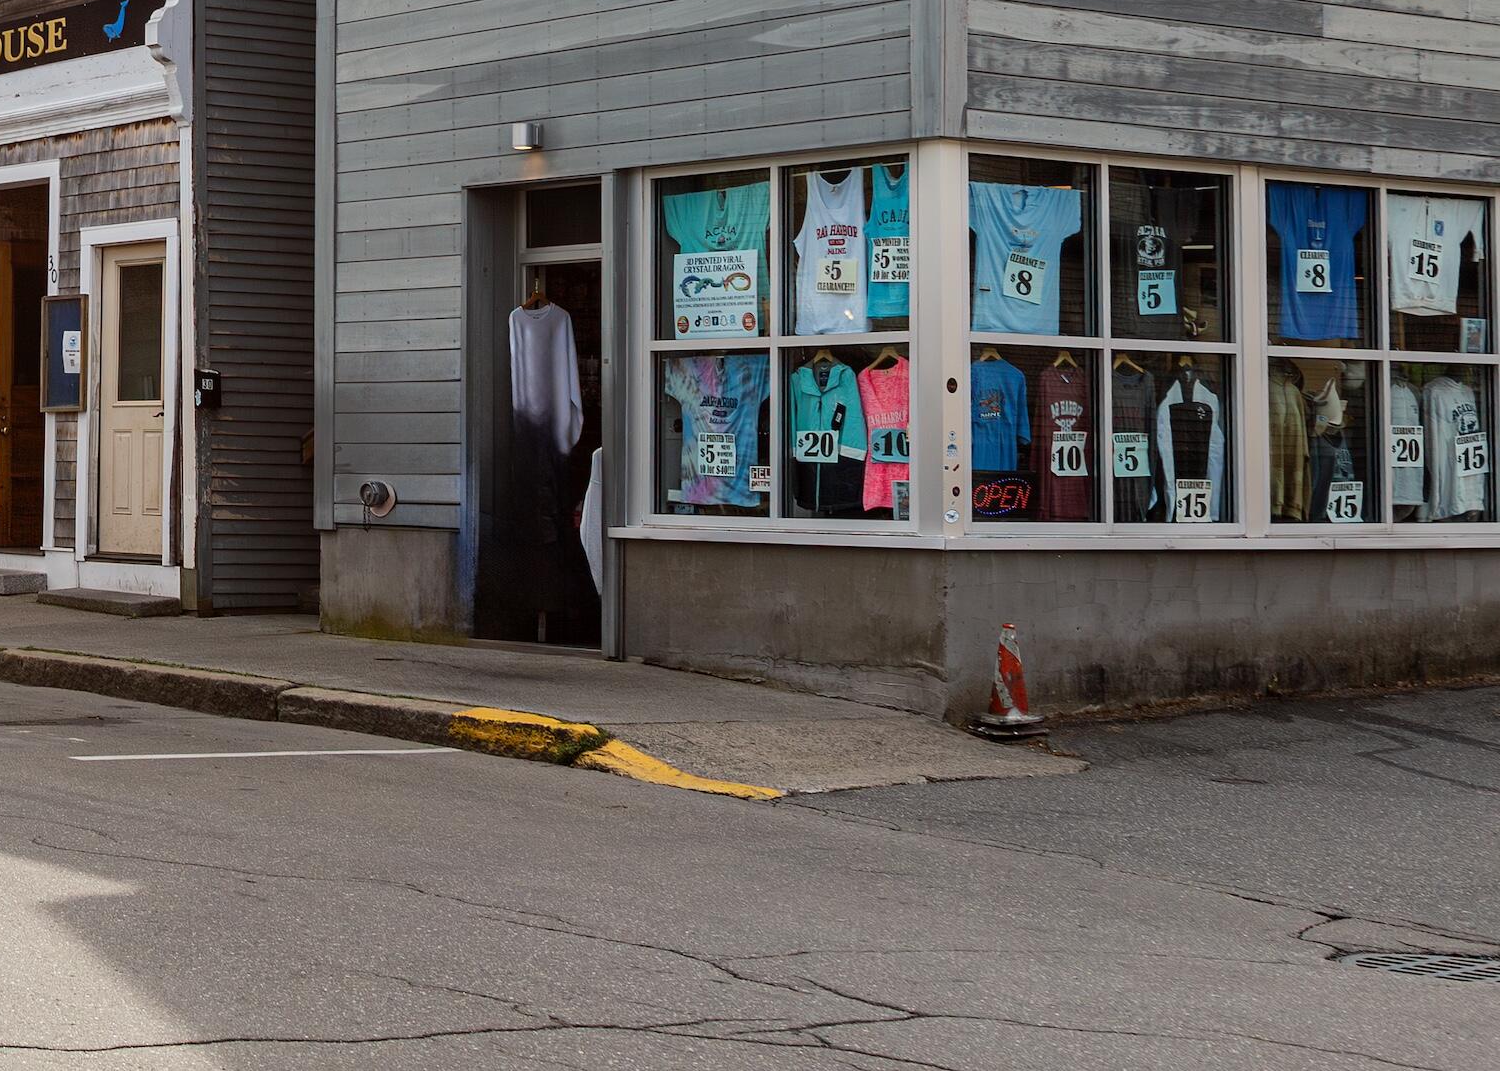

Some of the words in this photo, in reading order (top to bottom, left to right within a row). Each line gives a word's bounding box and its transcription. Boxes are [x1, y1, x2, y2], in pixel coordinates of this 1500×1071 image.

[683, 265, 713, 274] CRYSTAL
[713, 263, 745, 273] DRAGONS
[694, 256, 722, 265] PRINTED
[824, 260, 842, 281] $5
[874, 248, 890, 269] $5
[1010, 253, 1038, 268] CLEARANCE
[1410, 252, 1439, 278] $15
[1010, 270, 1033, 296] $8
[1304, 264, 1325, 288] $8
[1141, 283, 1161, 309] $5
[798, 432, 834, 458] $20
[1114, 434, 1140, 443] CLEARANCE
[1392, 438, 1420, 462] $20
[700, 444, 715, 464] $5
[1052, 446, 1081, 471] $10
[1118, 446, 1139, 471] $5
[1457, 445, 1485, 471] $15
[972, 484, 1031, 509] OPEN
[1177, 493, 1207, 518] $15
[1328, 494, 1358, 519] $15
